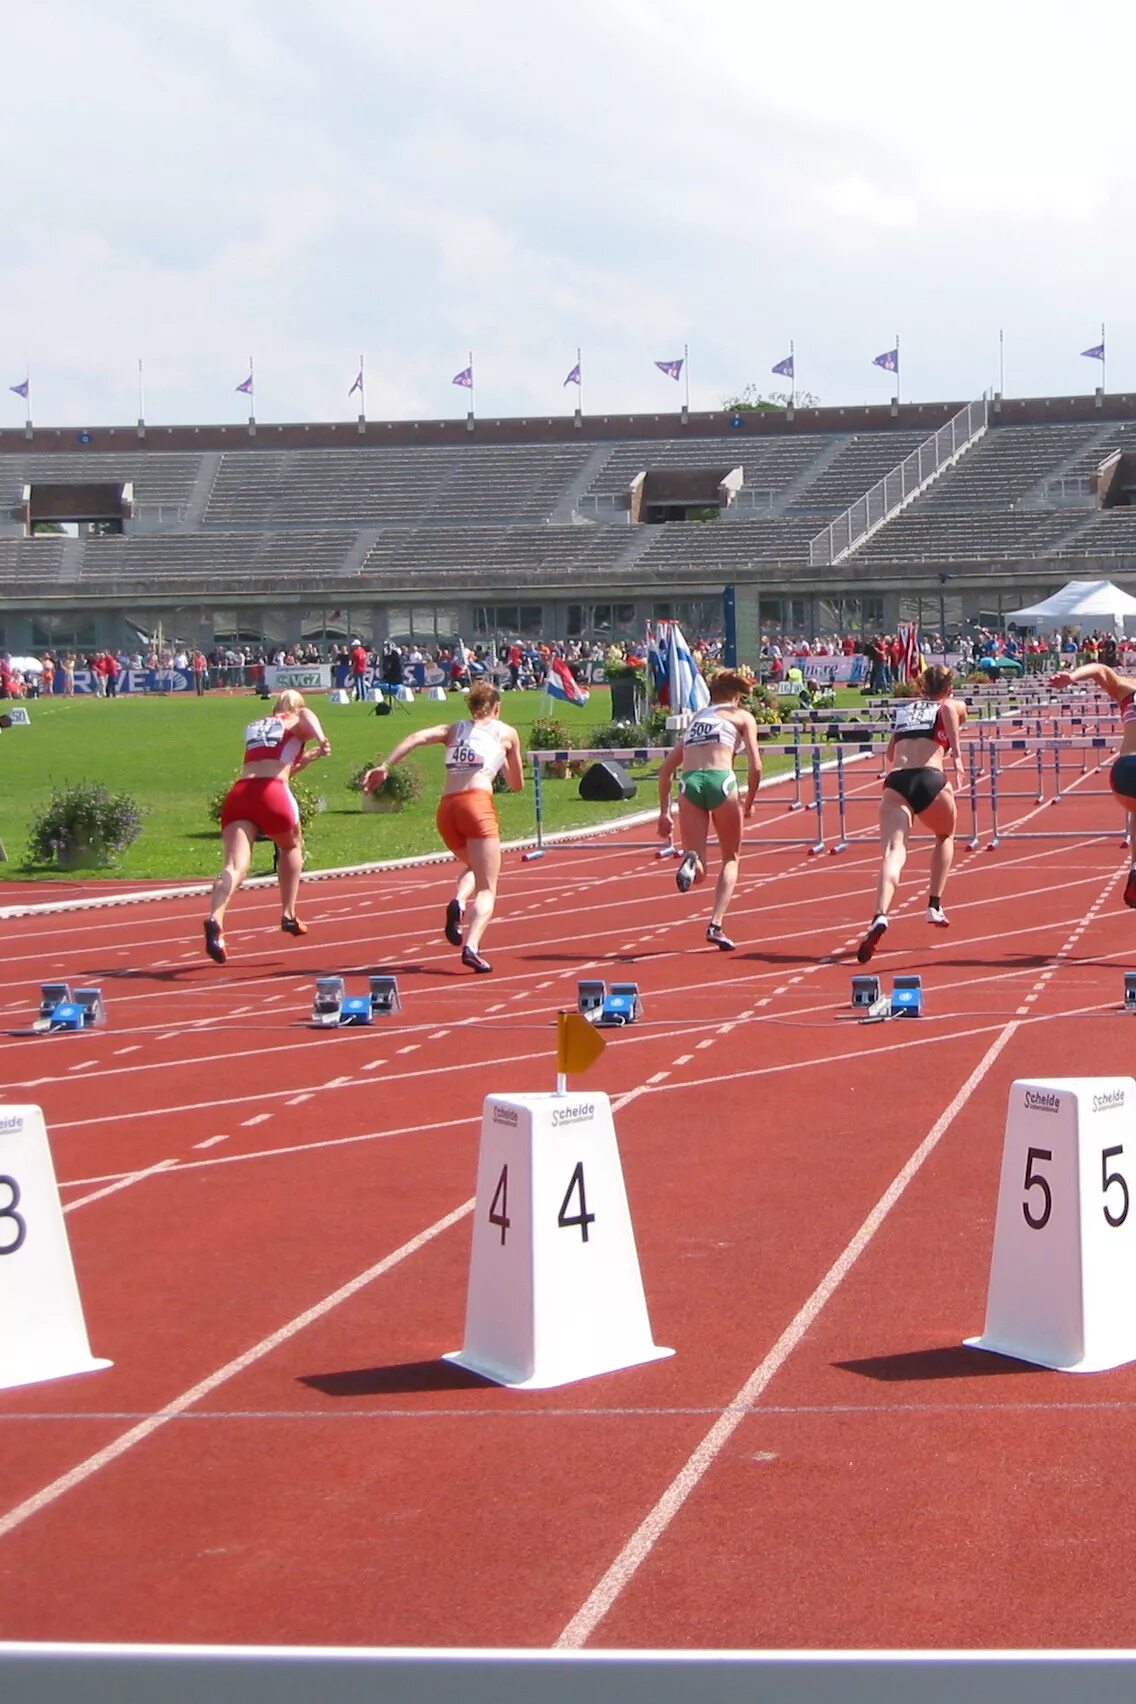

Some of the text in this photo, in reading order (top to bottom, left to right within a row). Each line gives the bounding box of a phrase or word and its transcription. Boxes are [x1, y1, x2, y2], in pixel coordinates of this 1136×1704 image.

[453, 746, 475, 762] 466
[690, 721, 712, 737] 500
[489, 1164, 510, 1245] 4
[558, 1161, 595, 1242] 4
[1023, 1147, 1052, 1230] 5
[1102, 1145, 1129, 1227] 5
